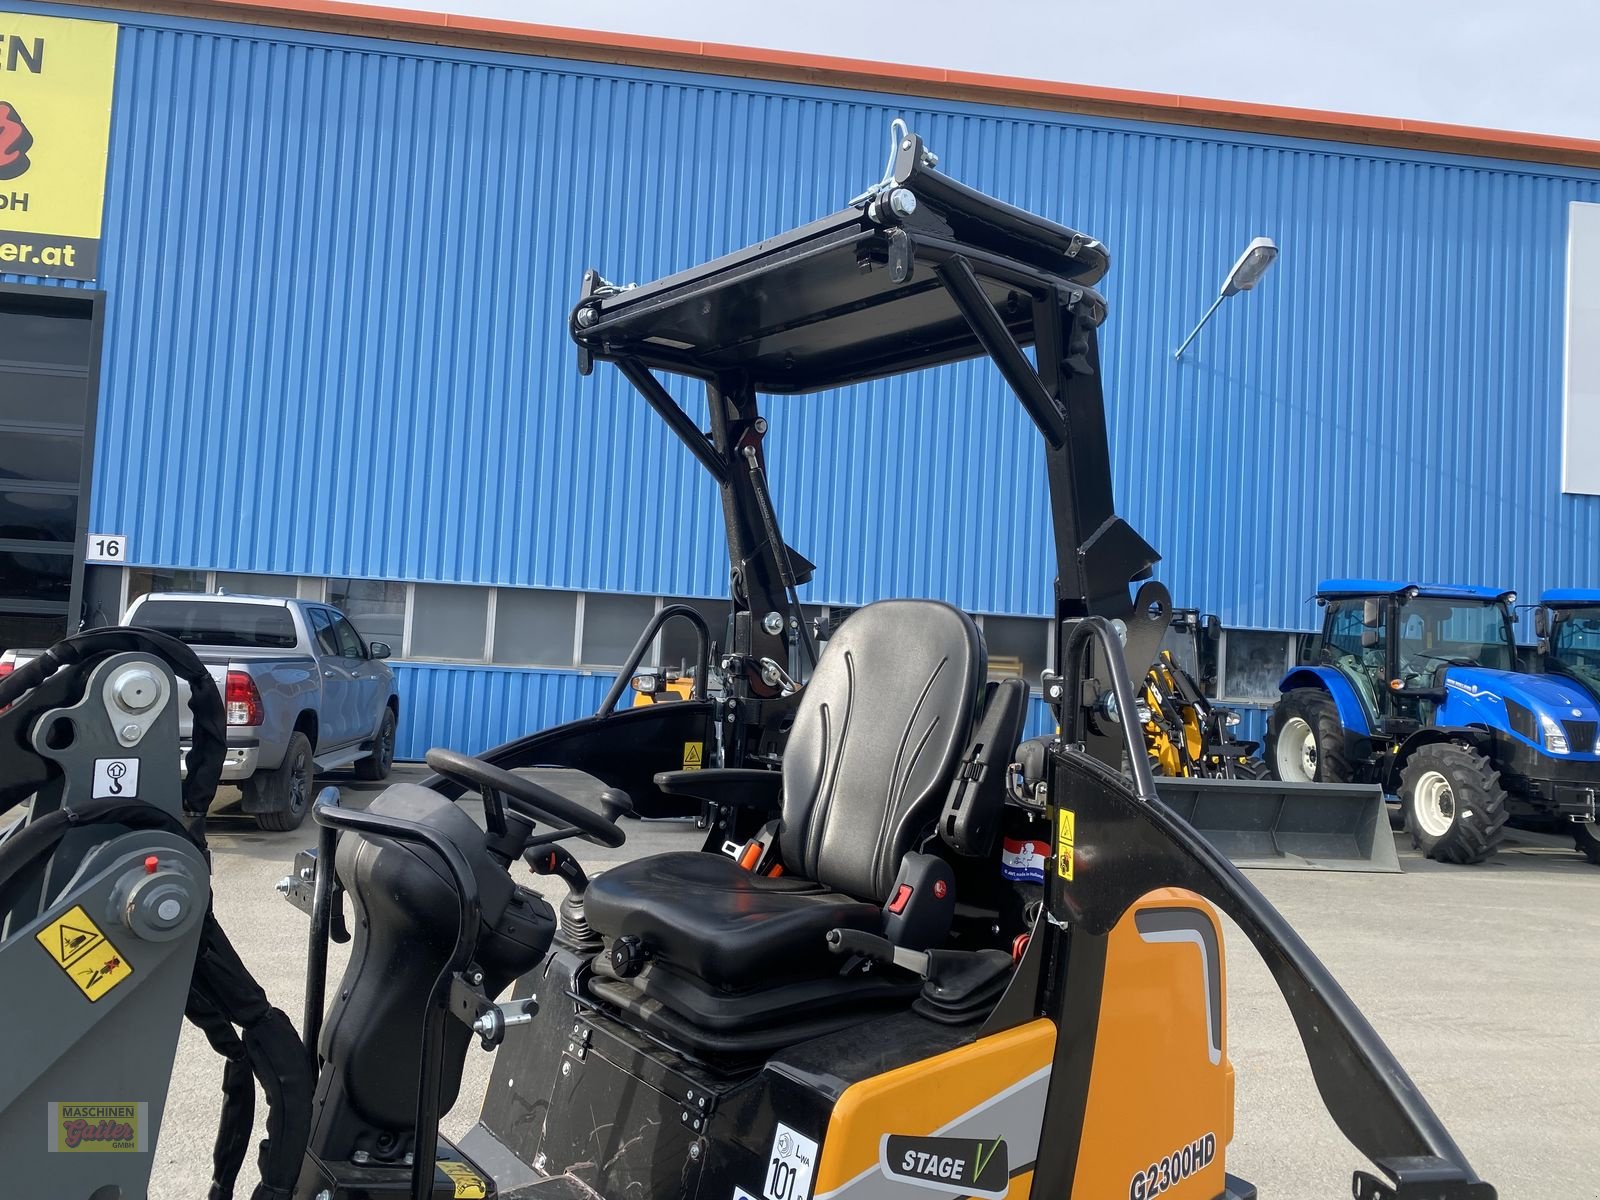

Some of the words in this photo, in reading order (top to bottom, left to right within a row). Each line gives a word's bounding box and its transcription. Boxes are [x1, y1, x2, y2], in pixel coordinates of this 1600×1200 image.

[96, 540, 119, 556] 16
[770, 1157, 797, 1200] 101
[902, 1150, 965, 1180] STAGE
[1129, 1132, 1216, 1200] G2300HD
